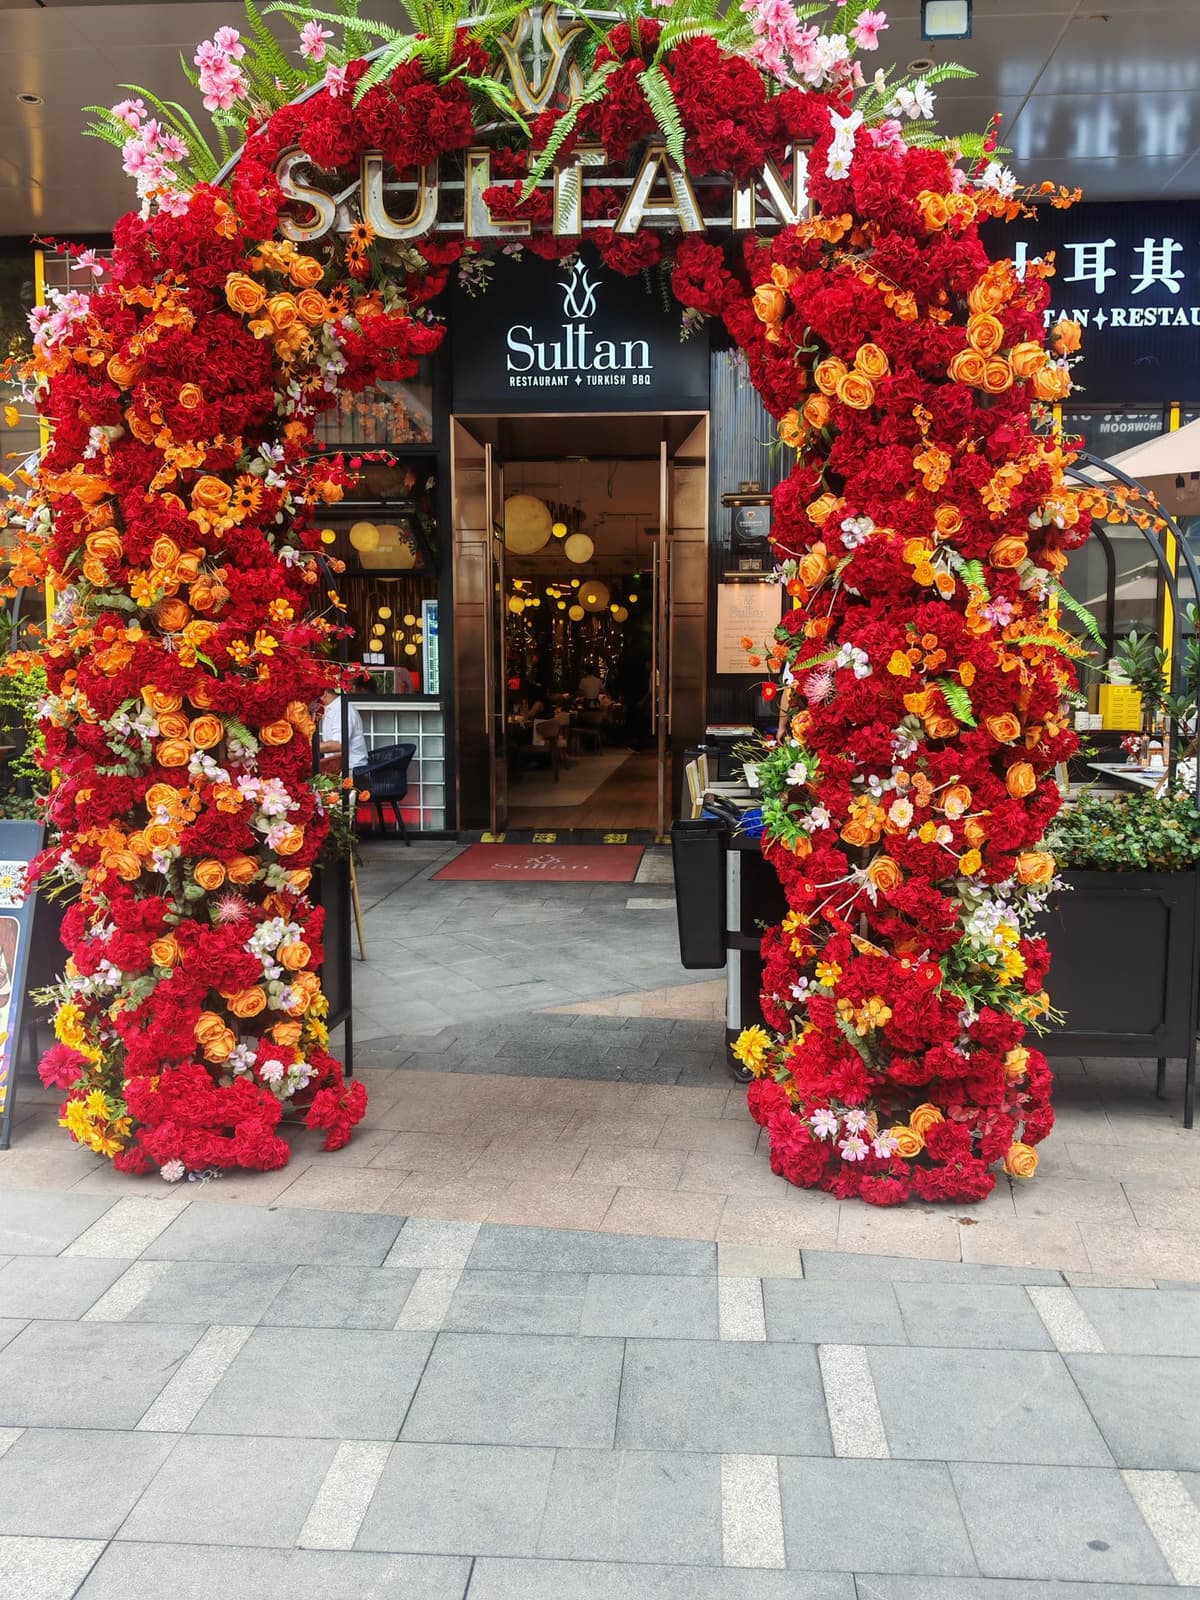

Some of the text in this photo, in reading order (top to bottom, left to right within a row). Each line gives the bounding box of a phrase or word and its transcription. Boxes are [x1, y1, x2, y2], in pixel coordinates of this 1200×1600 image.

[275, 140, 814, 242] SULTAN
[506, 323, 653, 372] Sultan
[509, 374, 651, 387] RESTAURANT TURKISH BBQ
